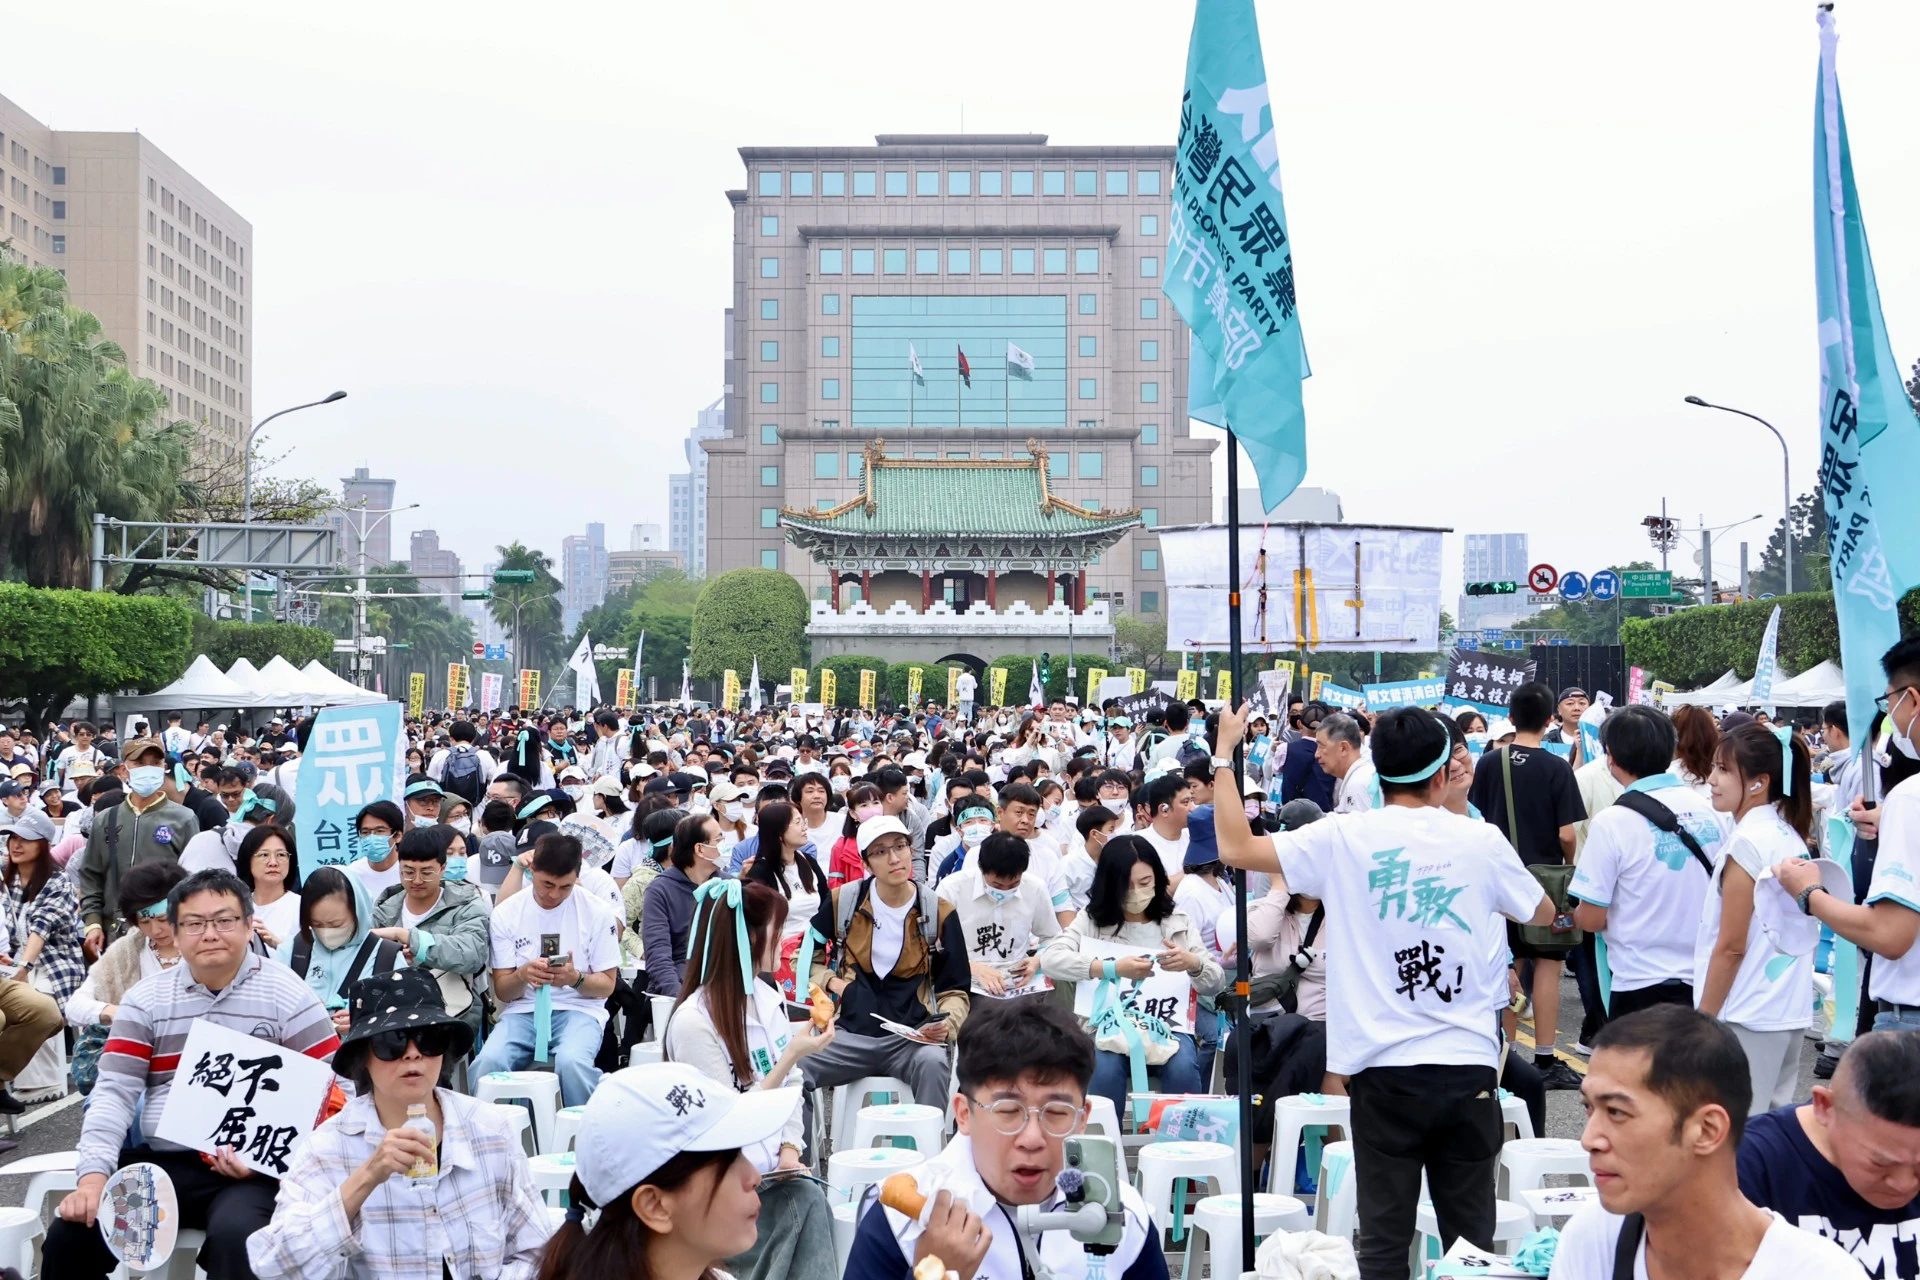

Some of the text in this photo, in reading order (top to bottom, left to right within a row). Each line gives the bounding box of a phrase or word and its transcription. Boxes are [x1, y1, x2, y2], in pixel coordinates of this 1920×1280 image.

[1232, 272, 1281, 337] PARTY
[1456, 660, 1525, 686] 板橋挺柯
[1368, 846, 1472, 934] 勇敢
[974, 922, 1014, 959] 戰!
[1393, 940, 1463, 1003] 戰!
[188, 1051, 283, 1106] 絕不
[665, 1084, 706, 1116] 戰!
[204, 1106, 299, 1176] 屈服
